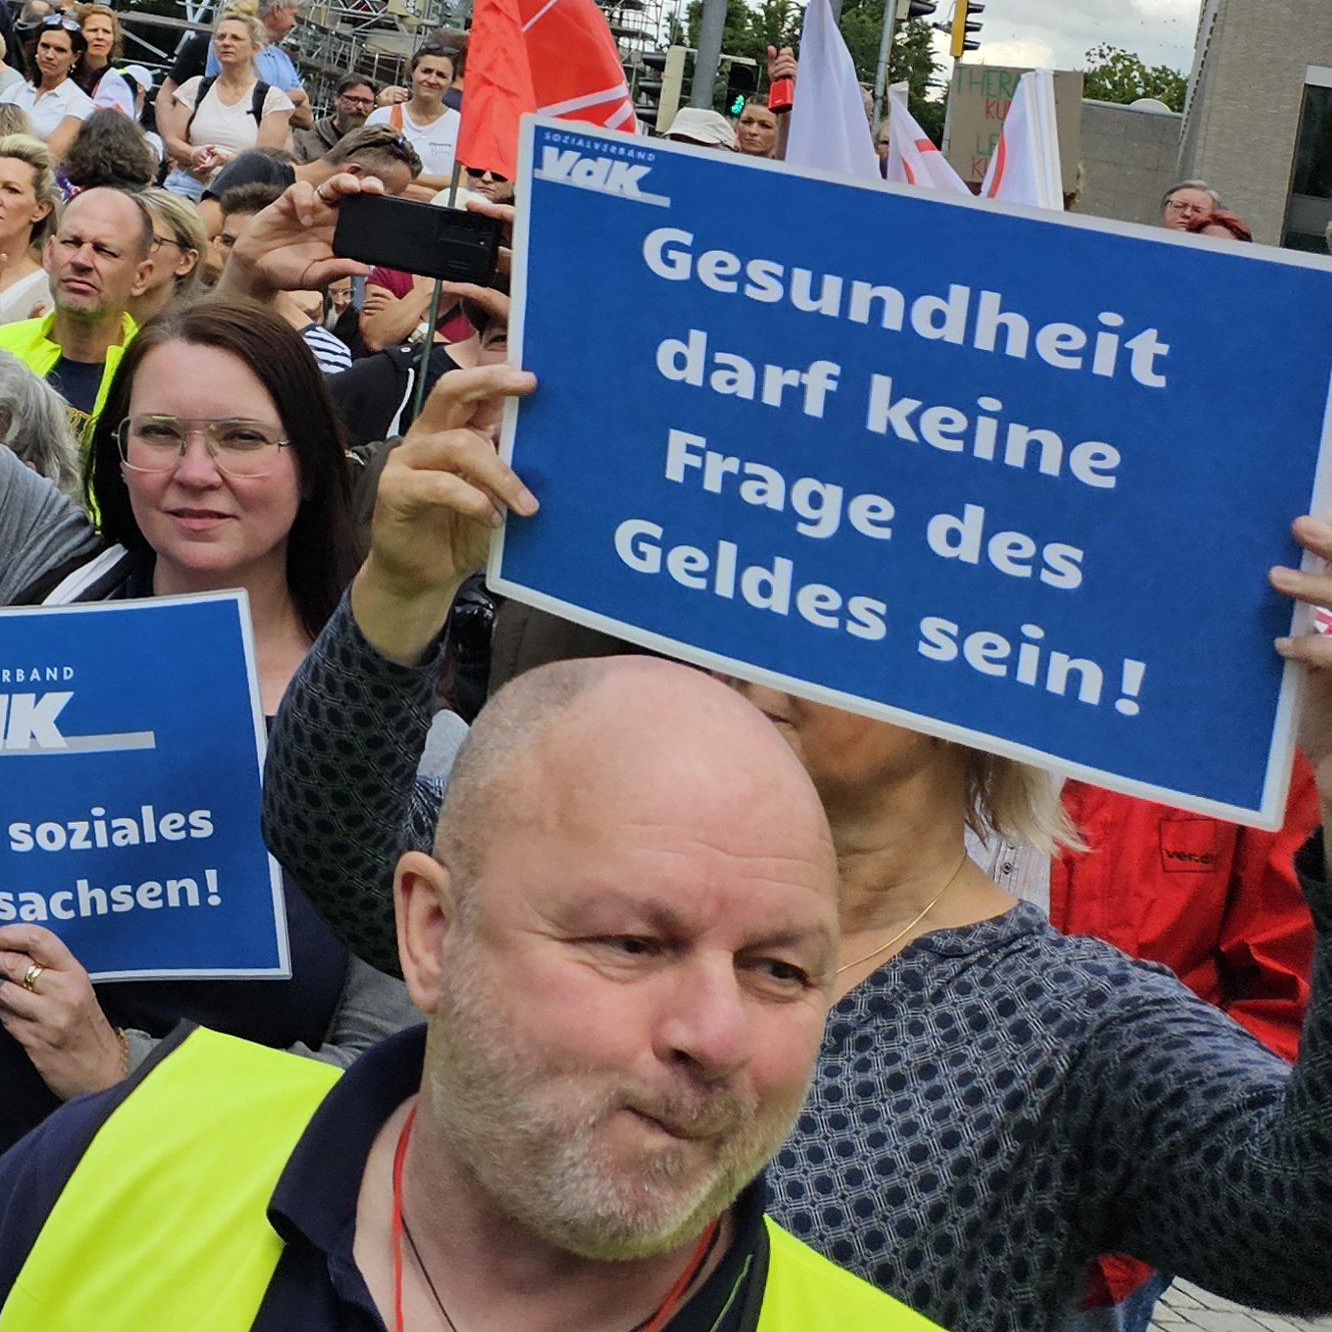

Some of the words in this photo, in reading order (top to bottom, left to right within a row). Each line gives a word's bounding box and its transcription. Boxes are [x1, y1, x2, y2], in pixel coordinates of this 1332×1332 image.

[536, 145, 654, 200] VdK
[543, 131, 657, 162] SOZIALVERBAND
[641, 226, 1171, 389] Gesundheit
[655, 328, 843, 418] darf
[864, 372, 1124, 490] keine
[663, 428, 896, 540] Frage
[925, 502, 1087, 590] des
[612, 518, 889, 642] Geldes
[916, 613, 1148, 718] sein!
[9, 803, 215, 854] soziales
